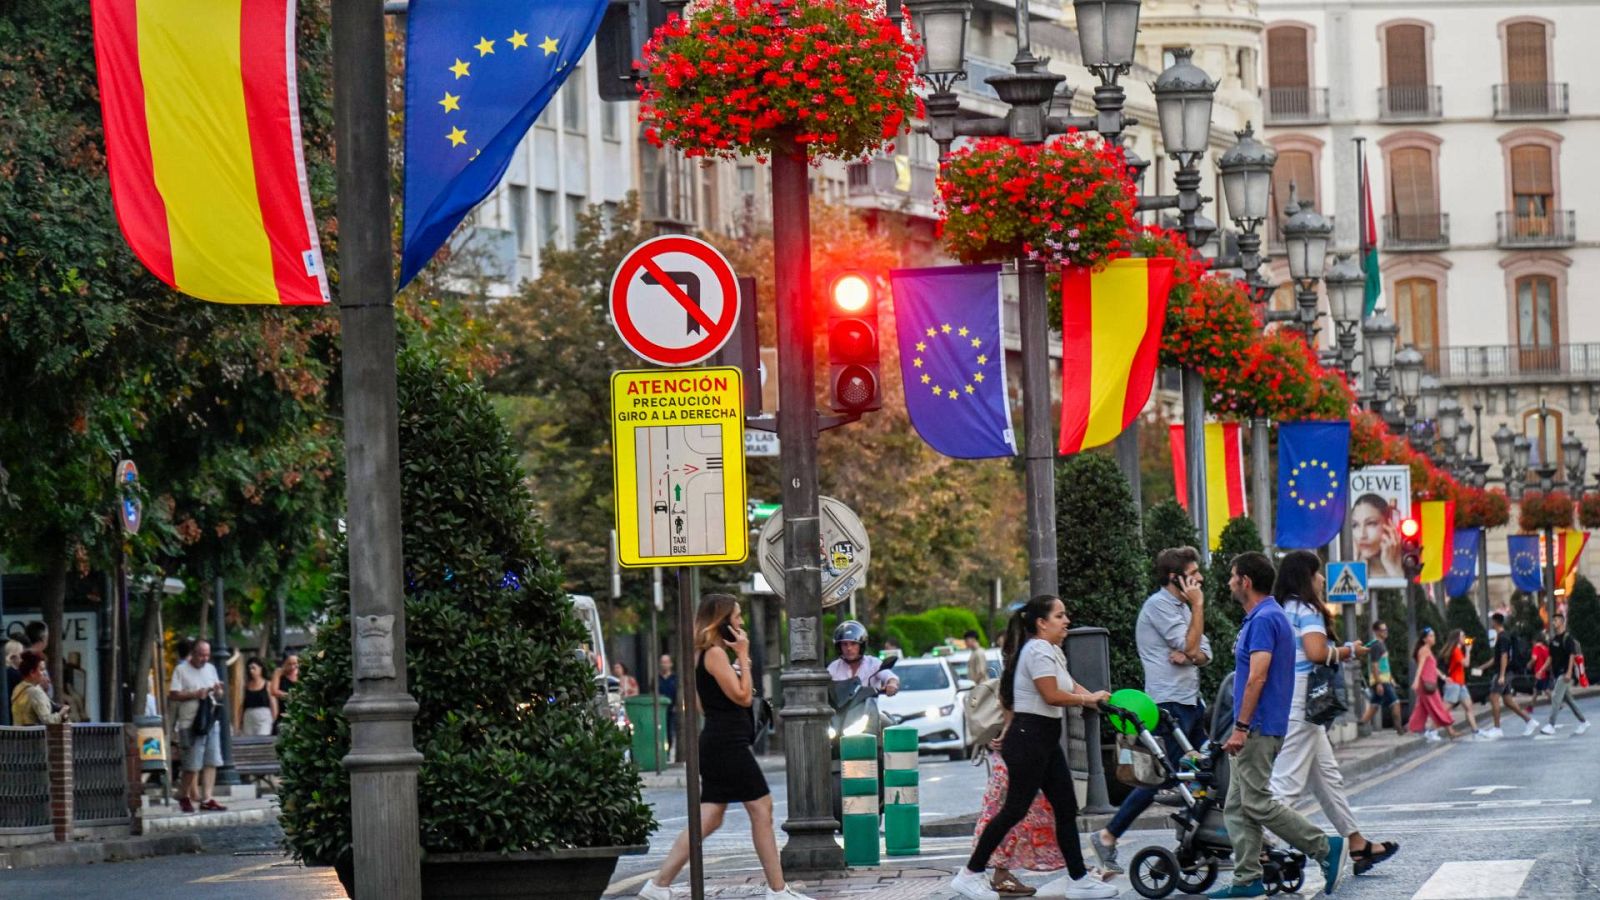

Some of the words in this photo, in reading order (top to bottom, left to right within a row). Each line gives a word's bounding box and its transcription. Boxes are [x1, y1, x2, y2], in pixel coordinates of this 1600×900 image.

[627, 375, 727, 395] ATENCIÓN
[633, 394, 721, 408] PRECAUCIÓN
[618, 410, 648, 422] GIRO
[651, 410, 659, 420] A
[662, 409, 677, 420] LA
[680, 408, 737, 419] DERECHA
[755, 433, 774, 442] LAS
[1352, 475, 1402, 492] OEWE
[673, 535, 687, 545] TAXI
[673, 545, 687, 554] BUS
